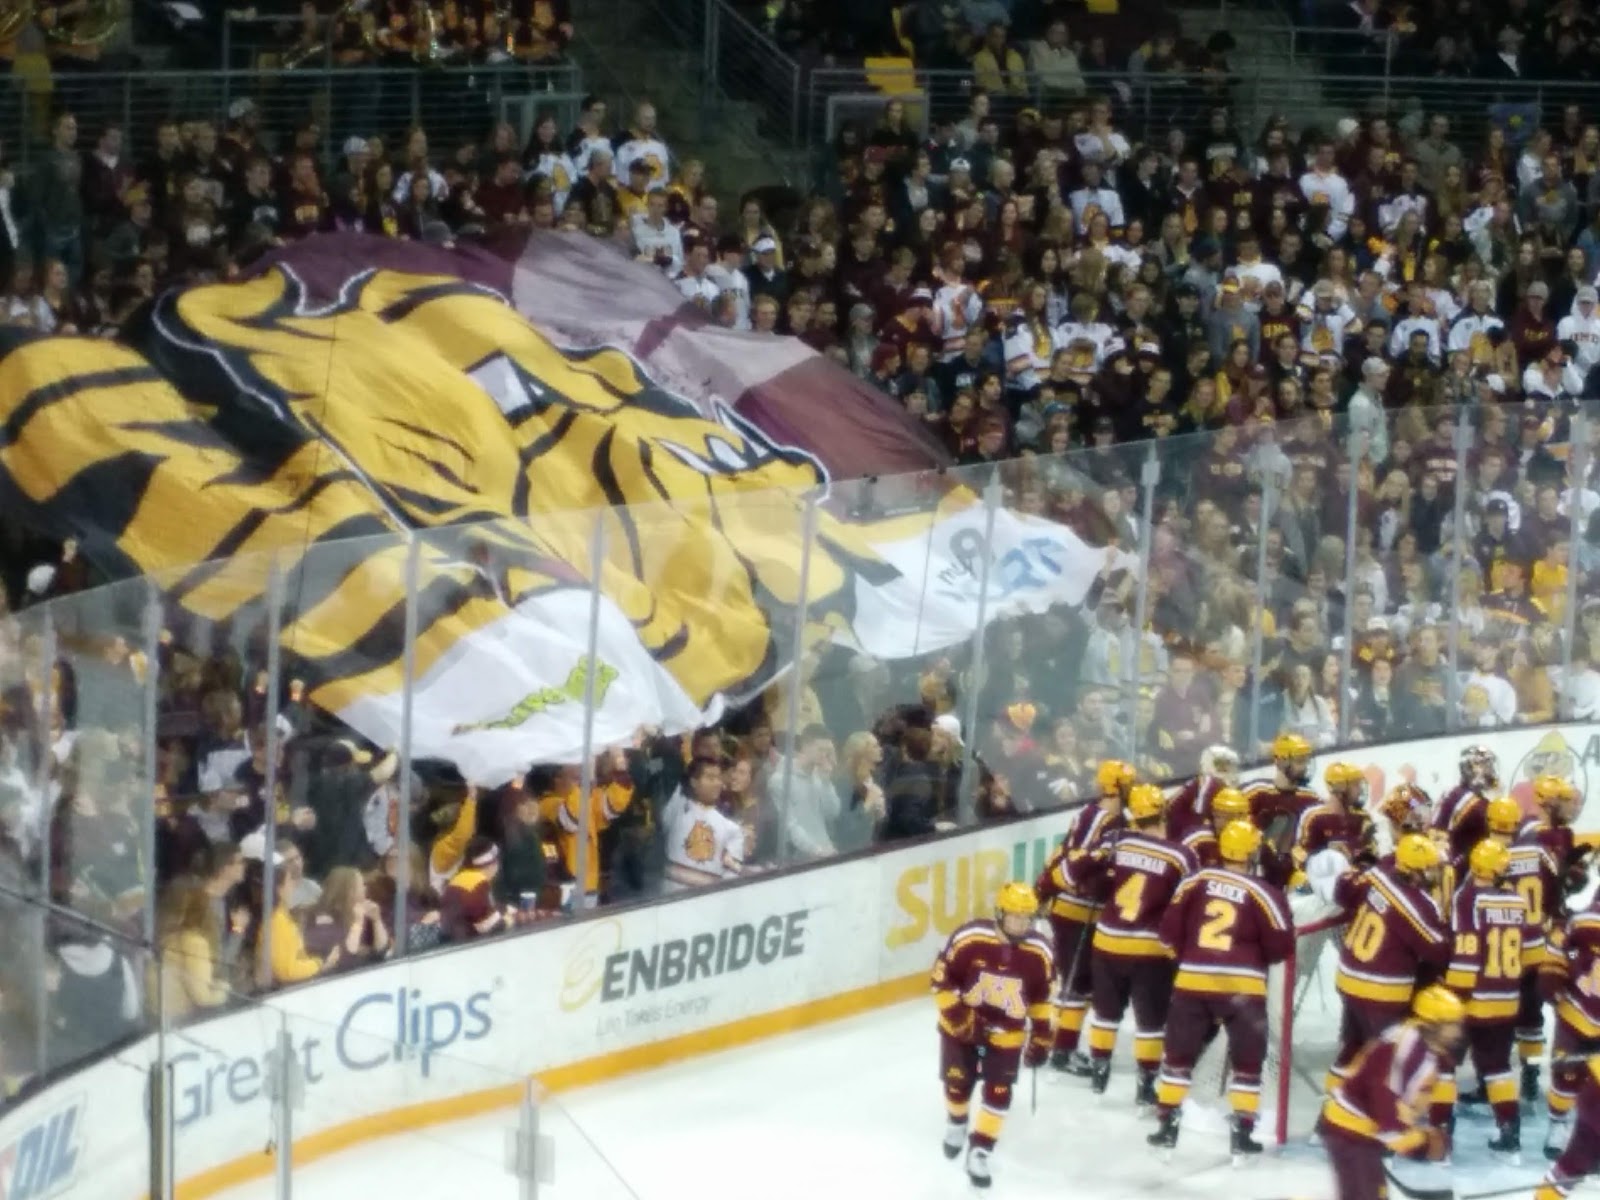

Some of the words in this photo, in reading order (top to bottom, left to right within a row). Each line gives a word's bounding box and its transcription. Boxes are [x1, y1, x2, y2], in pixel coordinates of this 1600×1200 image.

[884, 834, 1066, 949] SUB
[1115, 872, 1147, 922] 4
[600, 908, 809, 1003] ENBRIDGE
[1198, 899, 1237, 951] 2
[1344, 902, 1386, 963] 10
[1484, 926, 1522, 978] 18
[143, 1033, 324, 1130] Gret
[335, 986, 493, 1078] Clips
